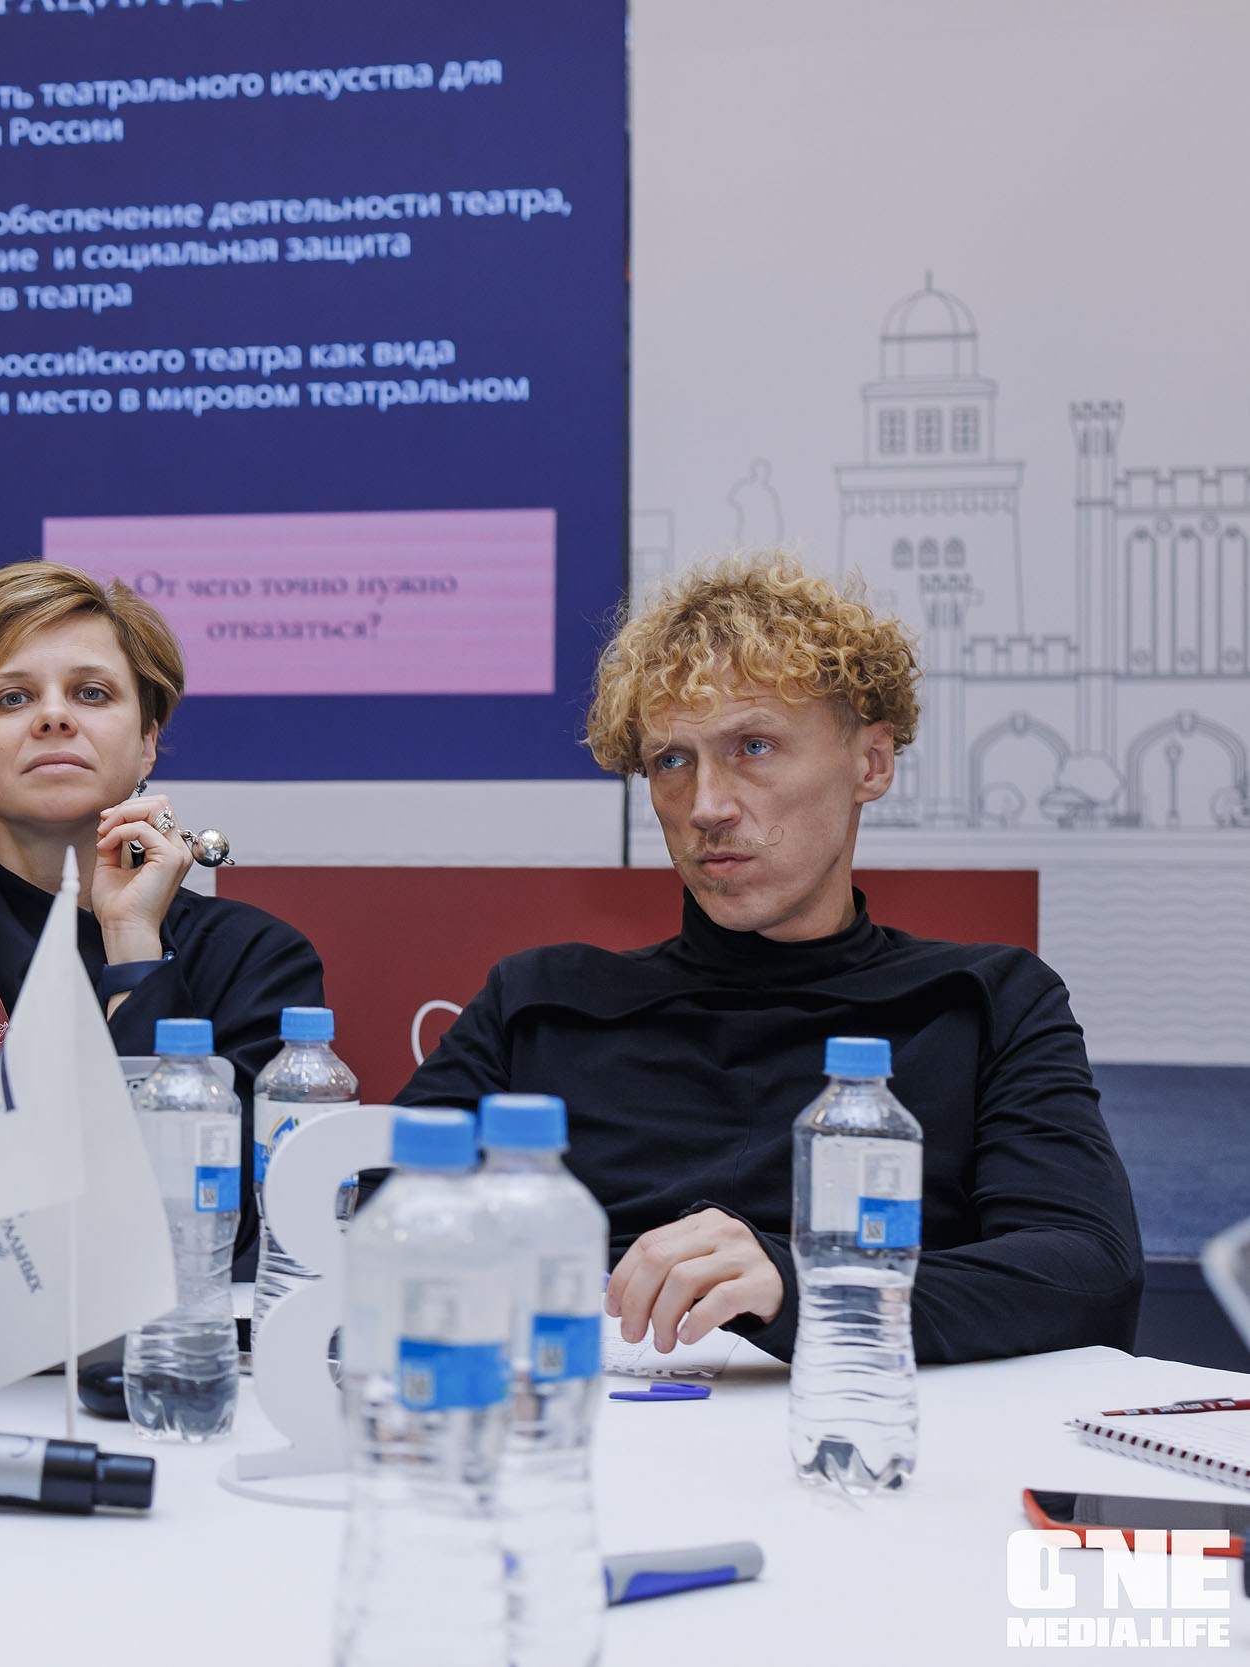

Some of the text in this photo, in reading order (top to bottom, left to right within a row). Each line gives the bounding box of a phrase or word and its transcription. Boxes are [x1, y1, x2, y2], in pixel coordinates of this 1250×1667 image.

[39, 72, 264, 111] театрального
[270, 62, 434, 101] искусства
[439, 58, 504, 93] для
[9, 116, 124, 147] России
[207, 192, 442, 232] деятельности
[447, 187, 572, 222] театра,
[53, 245, 76, 271] и
[81, 237, 279, 273] социальная
[285, 231, 411, 265] защита
[23, 282, 133, 314] театра
[190, 345, 303, 378] театра
[309, 341, 367, 369] как
[372, 339, 456, 372] вида
[16, 389, 113, 415] место
[118, 388, 141, 413] в
[146, 383, 300, 418] мировом
[306, 376, 530, 413] театральном
[134, 570, 459, 606] От чего точно нужно
[205, 611, 383, 642] отказаться?
